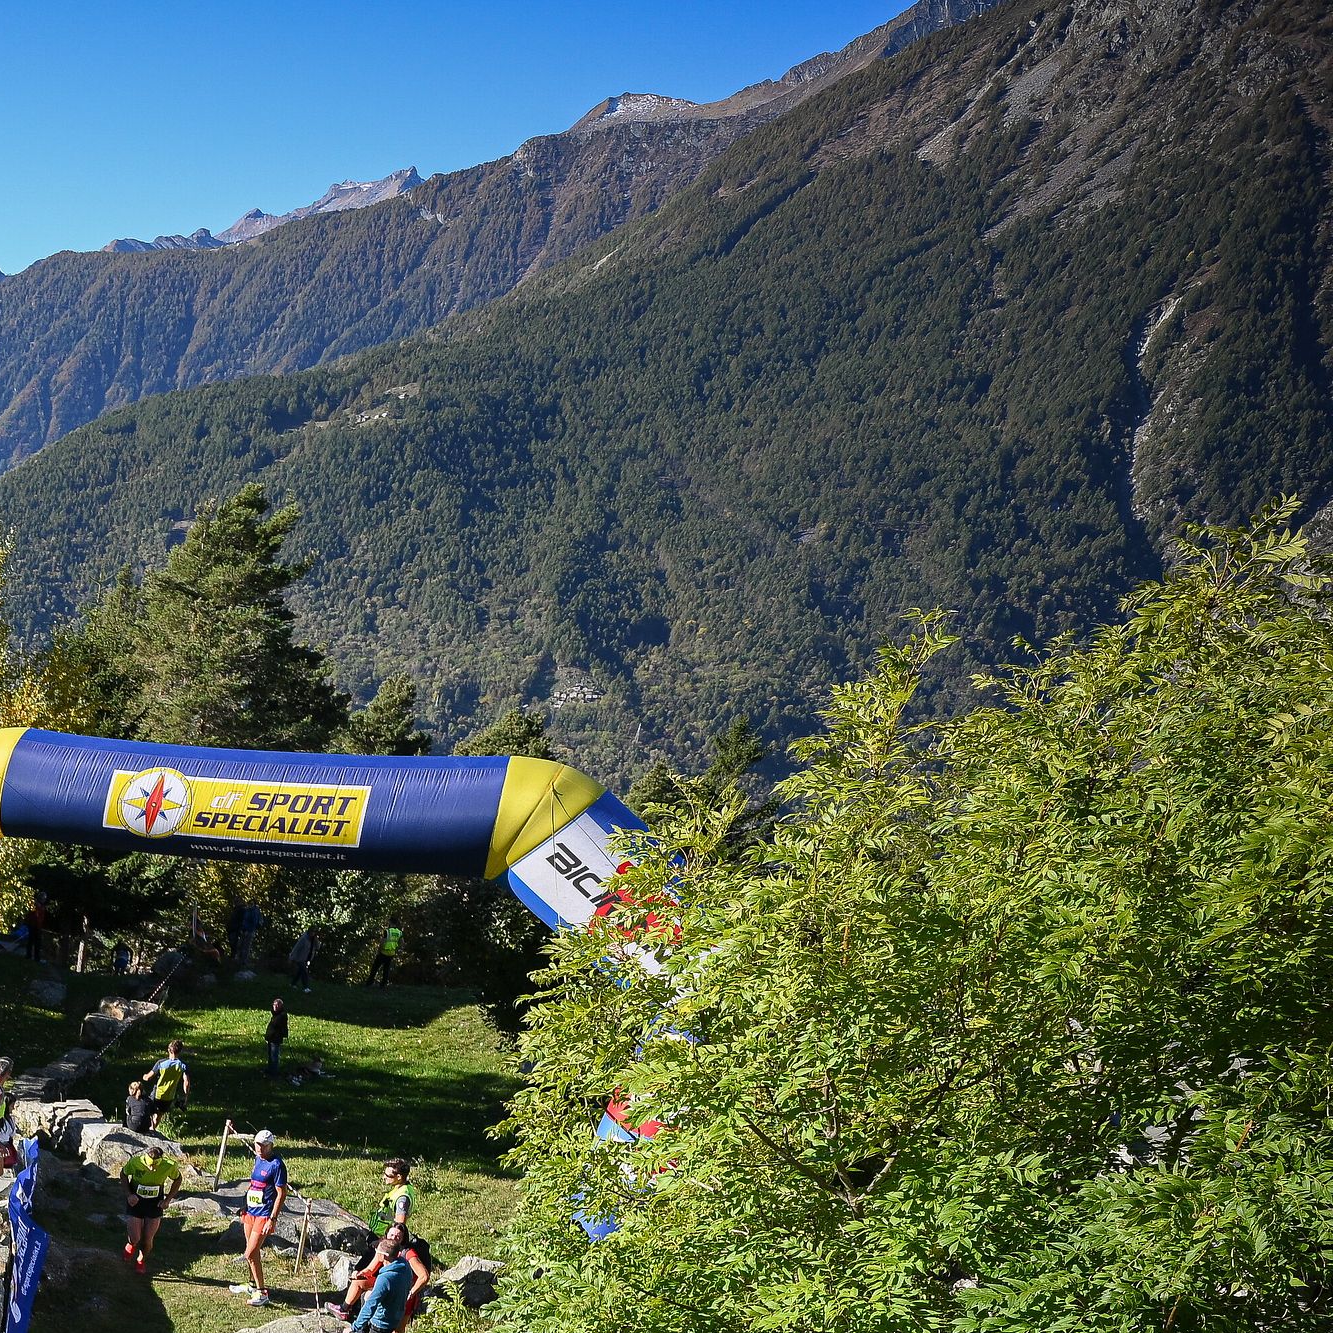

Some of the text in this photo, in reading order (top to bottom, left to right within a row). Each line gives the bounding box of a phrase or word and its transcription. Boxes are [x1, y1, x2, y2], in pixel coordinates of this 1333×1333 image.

[246, 792, 358, 816] SPORT
[192, 811, 350, 838] SPECIALIST
[249, 1196, 262, 1204] 102
